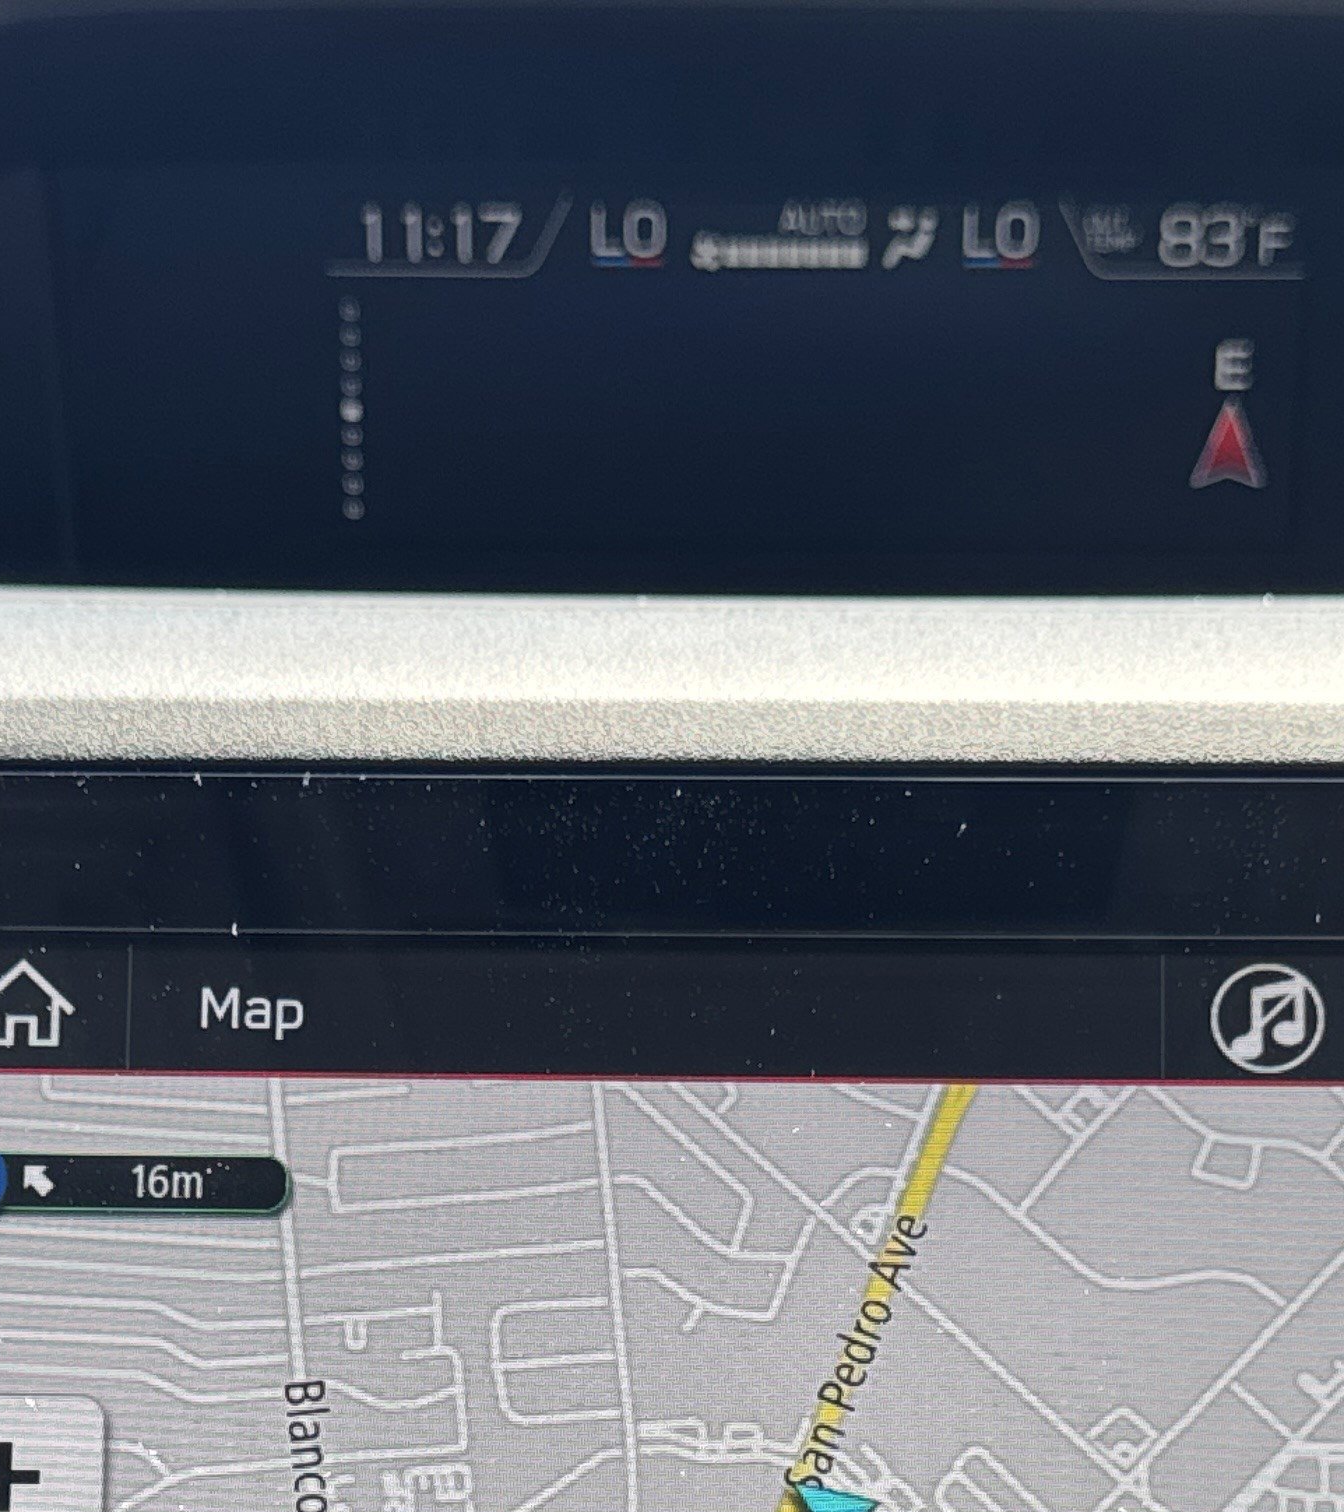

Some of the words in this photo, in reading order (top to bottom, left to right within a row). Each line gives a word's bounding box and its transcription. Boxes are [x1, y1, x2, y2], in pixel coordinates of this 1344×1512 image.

[361, 201, 523, 264] 11:17
[590, 201, 668, 259] LO
[777, 200, 869, 236] AUTO
[962, 200, 1041, 259] LO
[1214, 338, 1256, 391] E
[200, 988, 305, 1040] Map
[131, 1164, 203, 1200] 16m
[784, 1422, 846, 1490] San
[817, 1300, 894, 1412] Pedro
[867, 1214, 928, 1291] Ave
